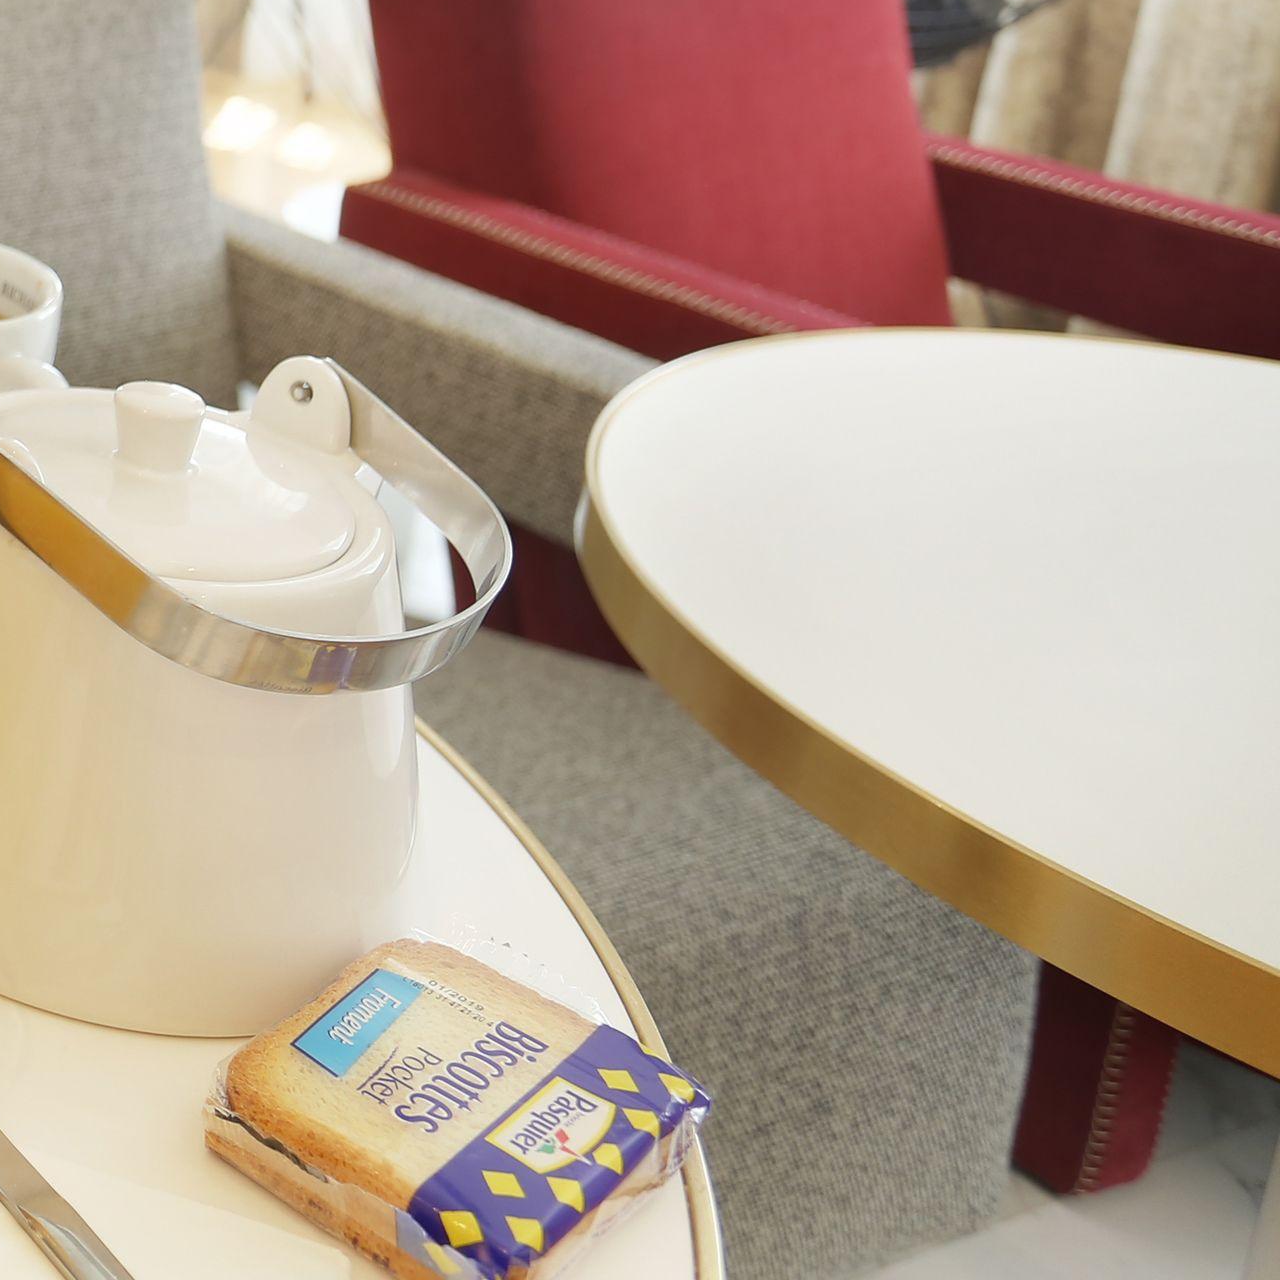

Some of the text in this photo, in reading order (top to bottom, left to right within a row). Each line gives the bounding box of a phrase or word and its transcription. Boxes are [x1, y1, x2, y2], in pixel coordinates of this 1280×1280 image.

[328, 986, 402, 1046] Froment
[428, 979, 485, 1012] 01/2019
[361, 1046, 443, 1105] Pocket
[394, 1021, 550, 1133] Biscottes
[509, 1089, 599, 1155] Pasquier
